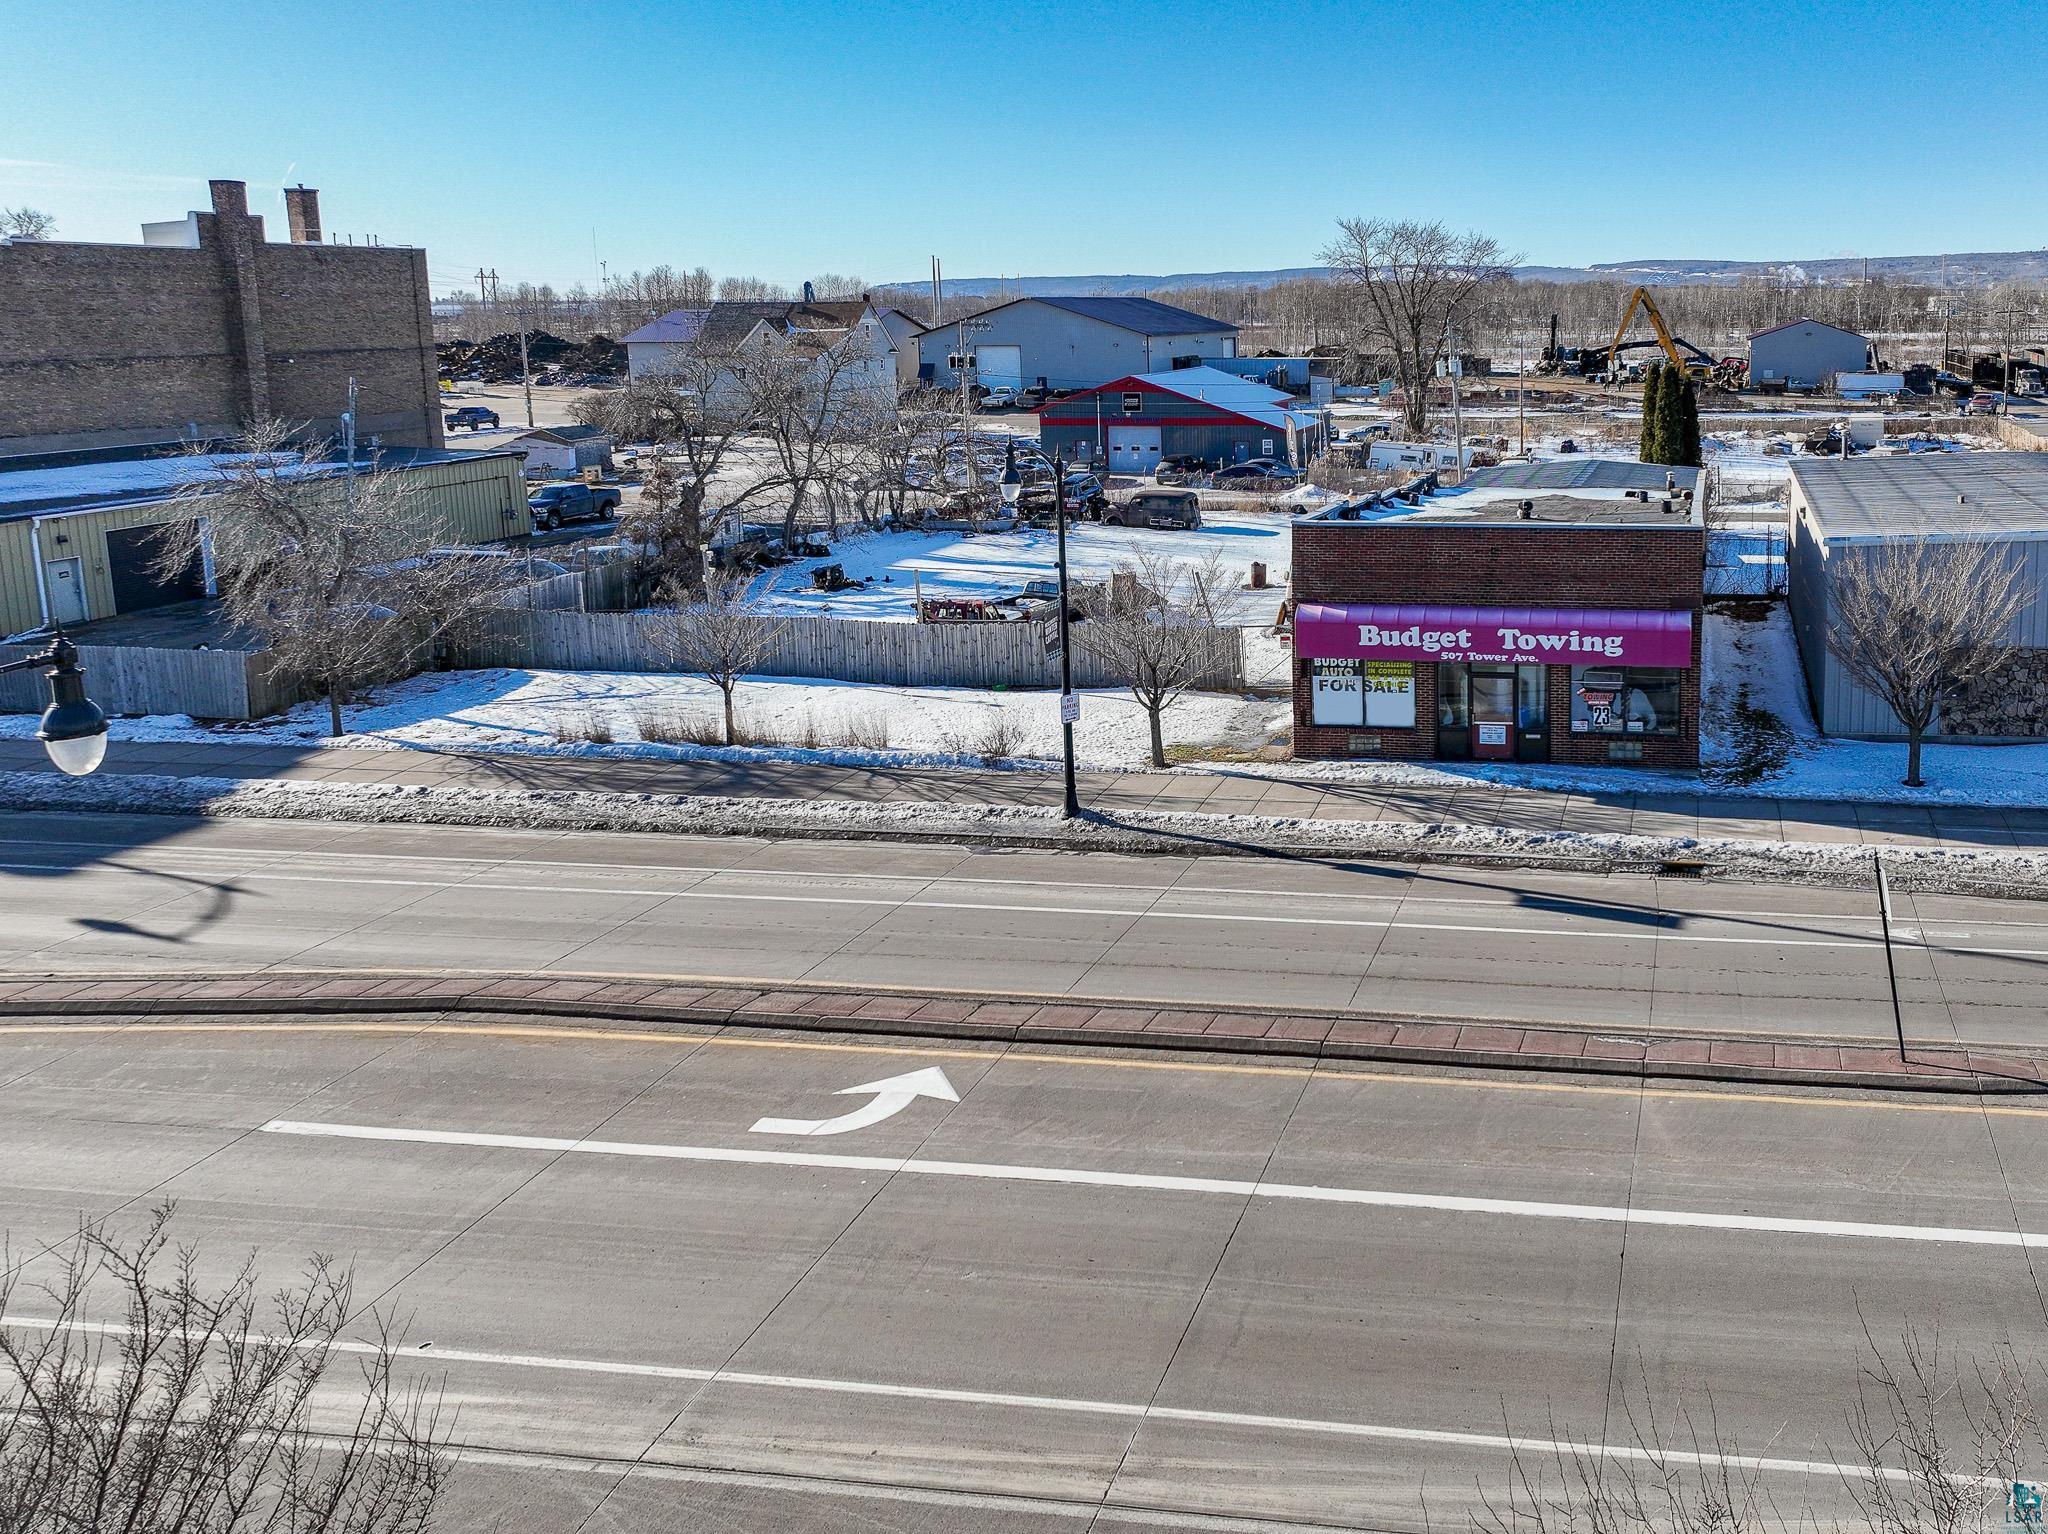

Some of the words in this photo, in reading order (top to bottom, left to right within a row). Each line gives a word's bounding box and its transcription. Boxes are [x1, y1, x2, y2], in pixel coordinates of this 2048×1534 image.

[1358, 625, 1471, 652] Budget
[1497, 628, 1624, 657] Towing
[1314, 658, 1360, 667] BUDGET
[1440, 651, 1464, 661] 507
[1466, 652, 1509, 662] Tower
[1512, 653, 1539, 662] Ave.
[1321, 667, 1354, 676] AUTO
[1319, 680, 1357, 692] FOR
[1364, 680, 1409, 693] SALE
[1594, 707, 1611, 725] 23
